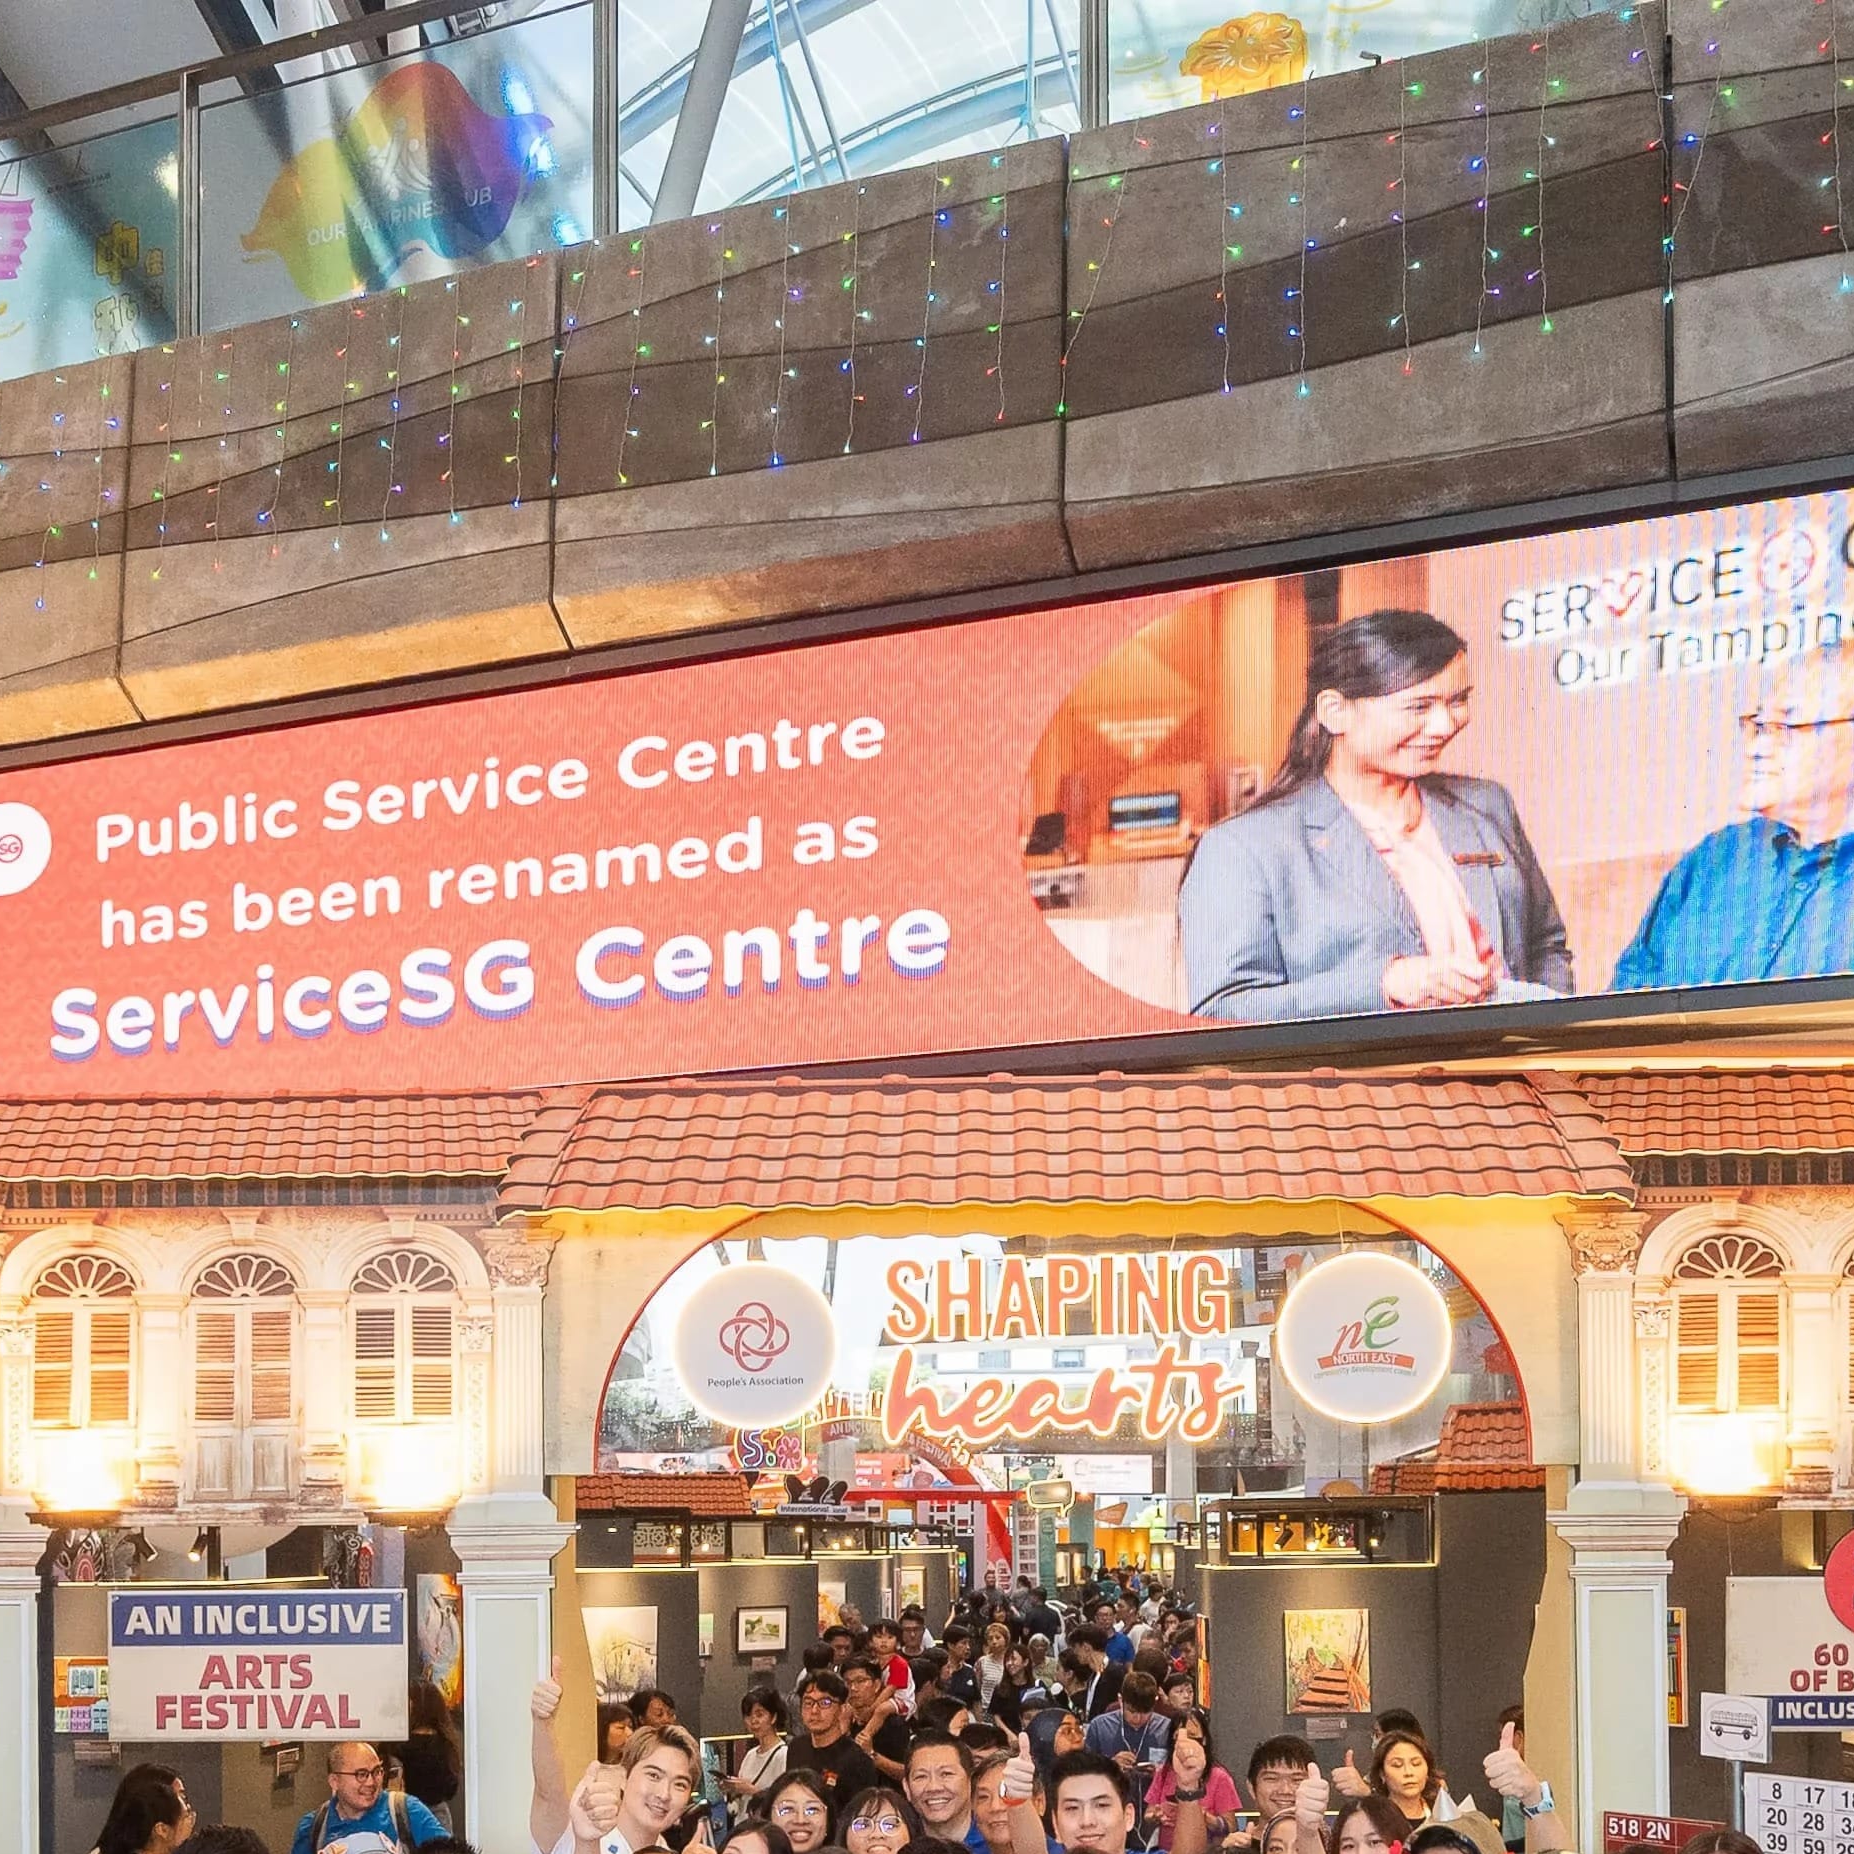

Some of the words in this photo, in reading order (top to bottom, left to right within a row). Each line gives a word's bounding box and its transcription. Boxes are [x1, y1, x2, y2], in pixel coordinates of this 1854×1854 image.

[1553, 646, 1633, 687] Our
[94, 796, 299, 863] Public
[321, 746, 589, 836] Service
[616, 713, 888, 791] Centre
[98, 894, 209, 949] has
[231, 874, 403, 938] been
[426, 815, 764, 911] renamed
[790, 813, 881, 868] as
[49, 937, 537, 1063] ServiceSG
[573, 904, 951, 1009] Centre
[886, 1256, 1230, 1339] SHAPING
[1333, 1354, 1367, 1365] NORTH
[1372, 1352, 1397, 1364] EAST
[707, 1377, 747, 1389] People's
[749, 1376, 804, 1386] Association
[885, 1345, 1245, 1443] hearts
[780, 1505, 829, 1513] International
[124, 1605, 183, 1636] AN
[193, 1602, 392, 1635] INCLUSIVE
[1814, 1643, 1849, 1666] 60
[199, 1654, 314, 1690] ARTS
[1789, 1670, 1828, 1693] OF
[156, 1694, 361, 1730] FESTIVAL
[1772, 1783, 1782, 1800] 8
[1804, 1785, 1825, 1805] 17
[1607, 1818, 1639, 1837] 518
[1646, 1821, 1671, 1841] 2N
[1766, 1807, 1787, 1826] 20
[1803, 1812, 1824, 1832] 28
[1766, 1833, 1788, 1852] 39
